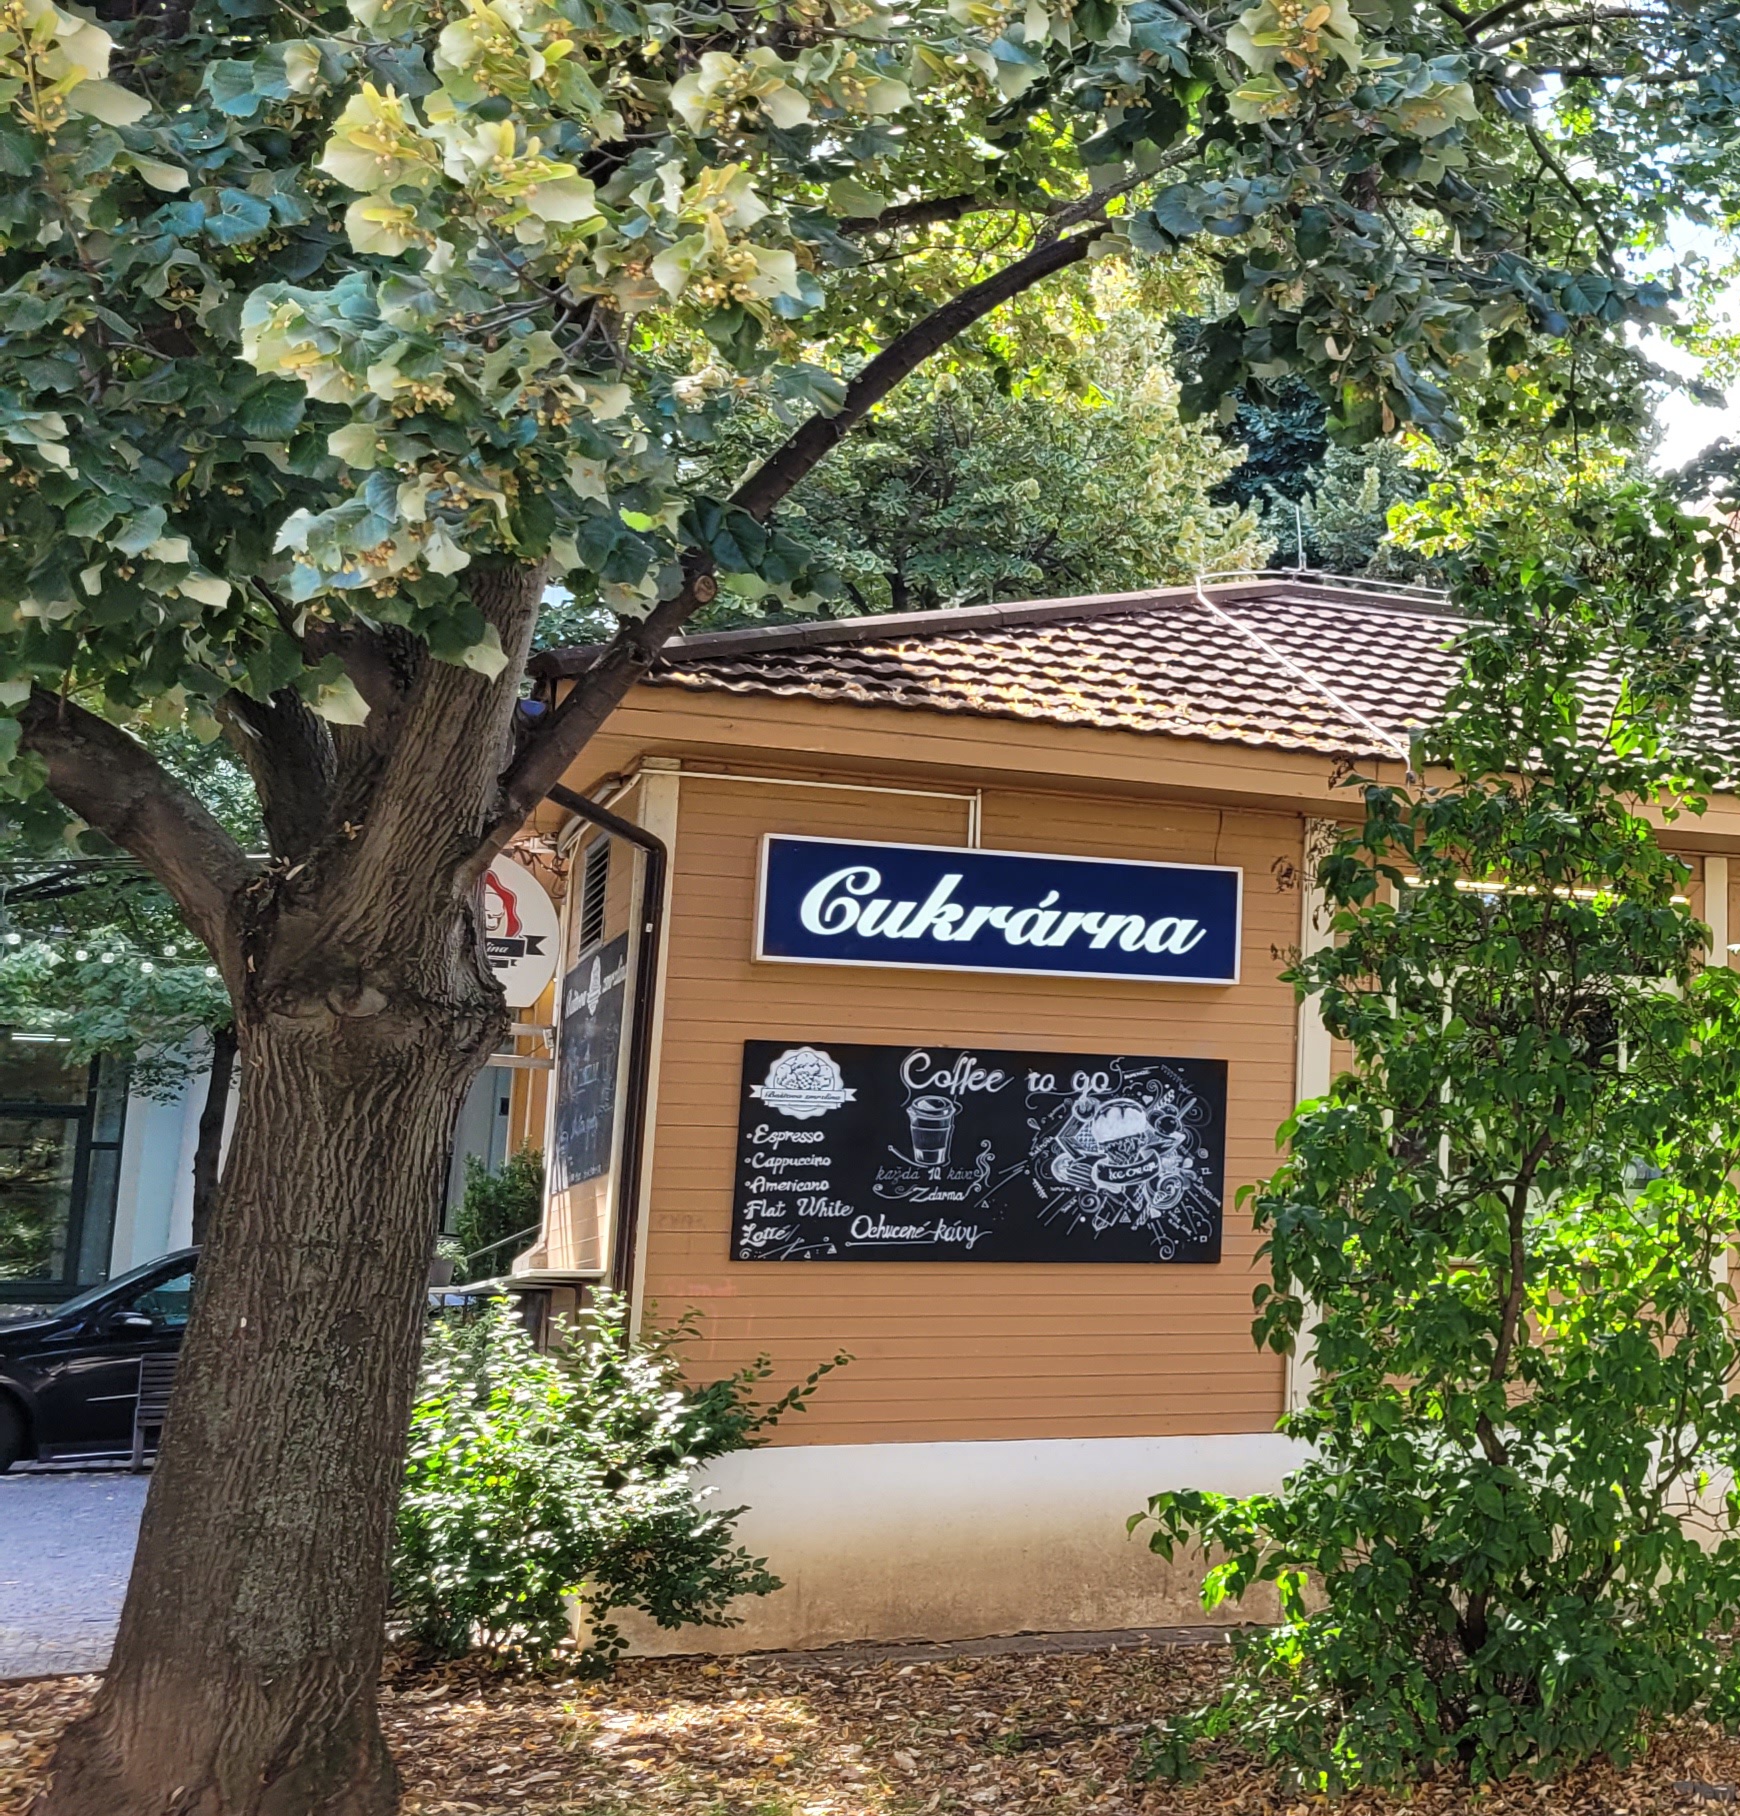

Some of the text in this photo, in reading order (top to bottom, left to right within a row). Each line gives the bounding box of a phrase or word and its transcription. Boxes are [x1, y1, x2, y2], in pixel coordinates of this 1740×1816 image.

[800, 865, 1207, 955] Cukrárna
[902, 1051, 1113, 1099] Coffee to go
[752, 1124, 825, 1150] Espresso
[751, 1152, 832, 1175] Cappuccino
[875, 1165, 921, 1185] každá
[947, 1166, 973, 1180] káva
[749, 1176, 830, 1194] Americano
[909, 1186, 965, 1203] Zdarma
[745, 1196, 854, 1220] Flat White
[850, 1214, 988, 1249] Ochucené kávy
